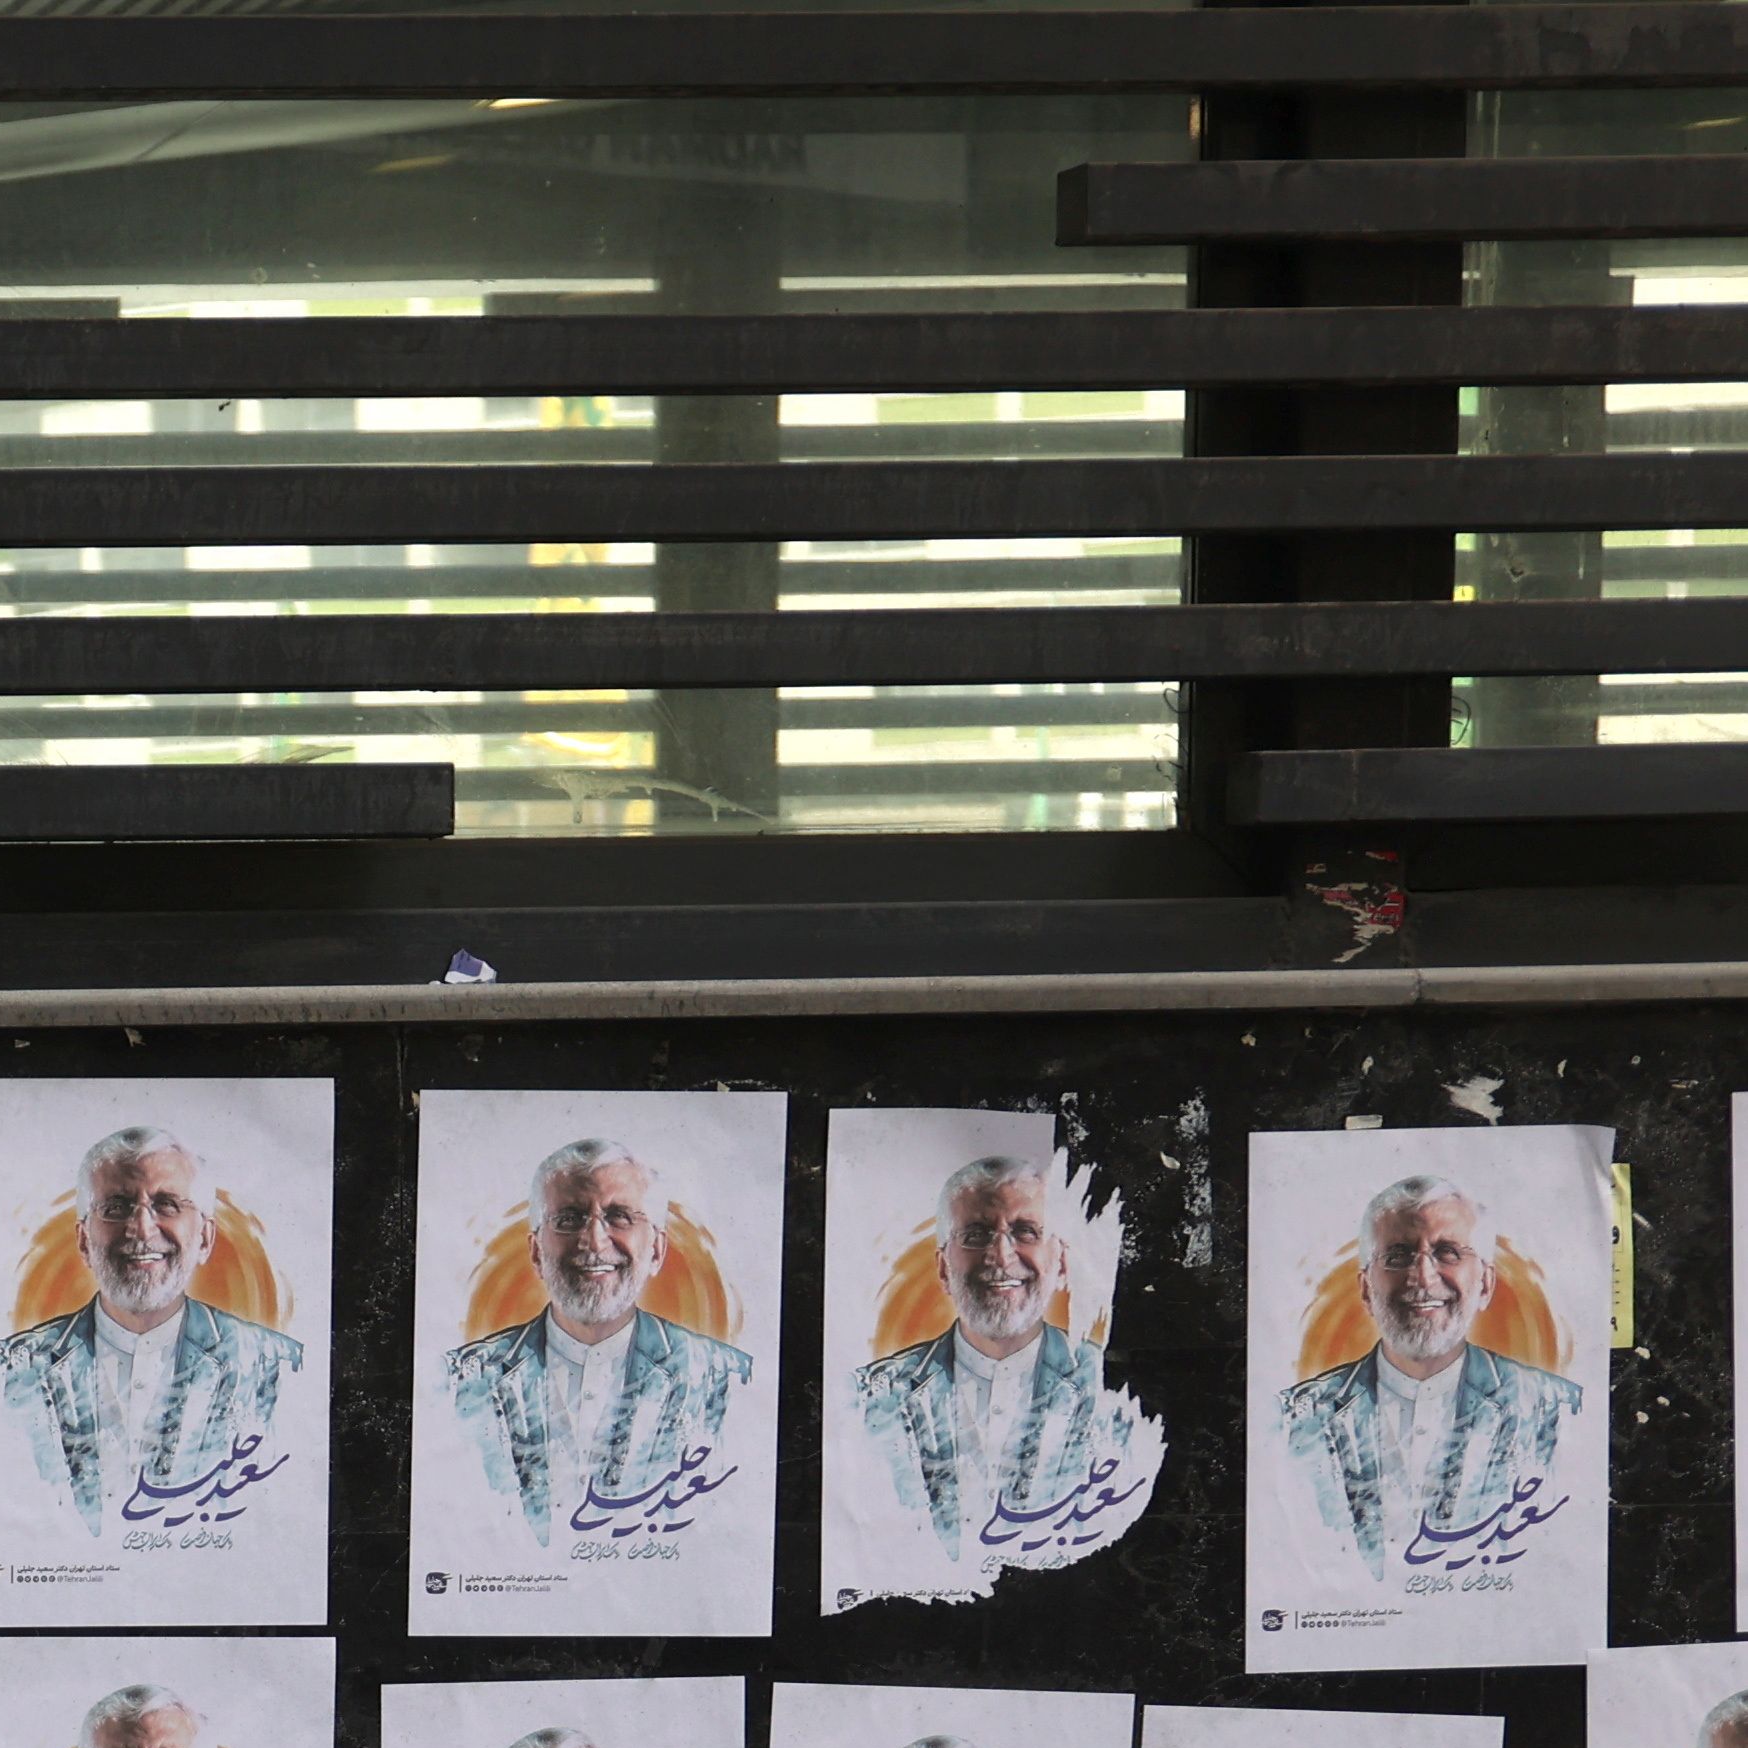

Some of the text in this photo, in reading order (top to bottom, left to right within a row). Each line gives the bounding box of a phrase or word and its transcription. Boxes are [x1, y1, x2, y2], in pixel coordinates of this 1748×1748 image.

[120, 1431, 290, 1528] سعید جلیلی
[569, 1443, 738, 1538] سعید جلیلی
[979, 1456, 1147, 1552] سعید جلیلی
[1403, 1474, 1570, 1571] سعید جلیلی
